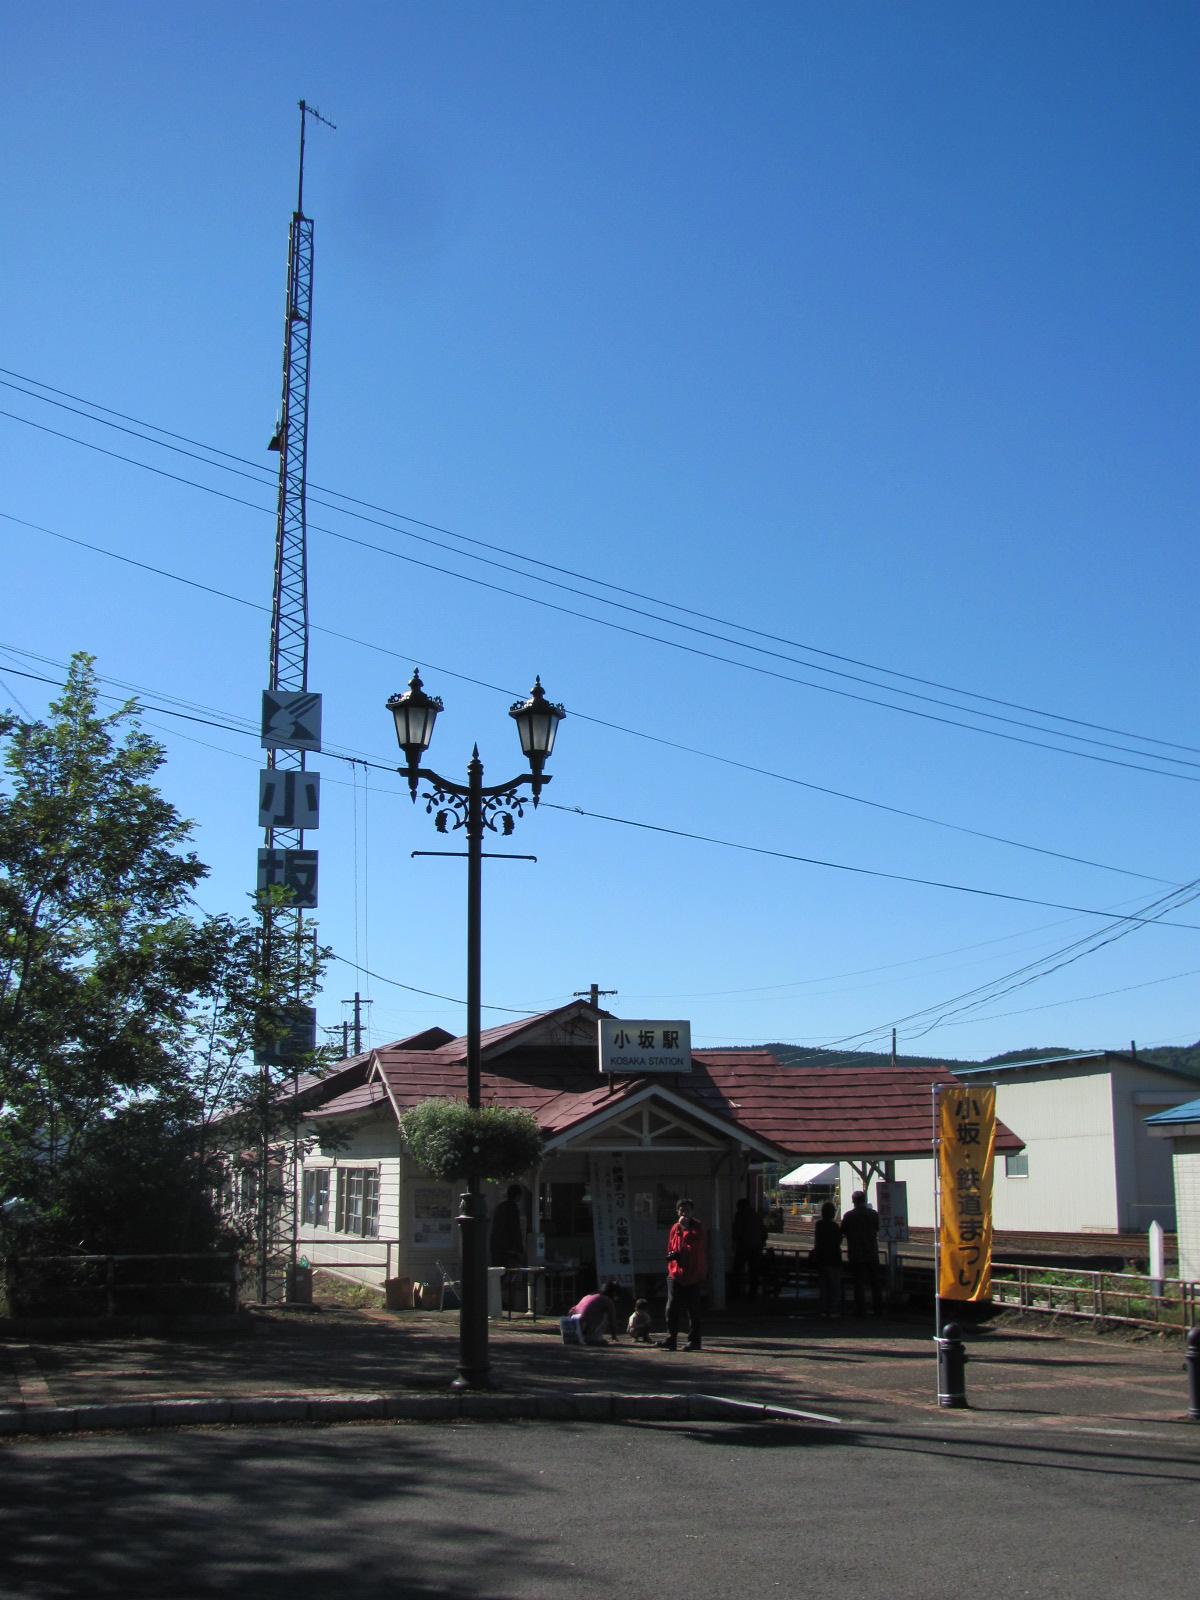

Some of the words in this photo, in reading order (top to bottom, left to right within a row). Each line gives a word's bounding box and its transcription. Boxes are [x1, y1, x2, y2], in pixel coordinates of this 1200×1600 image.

[614, 1030, 679, 1049] 小坂駅
[610, 1056, 647, 1066] KOSAKA
[648, 1056, 684, 1066] STATION
[955, 1098, 984, 1292] 小坂・鉄道まつり
